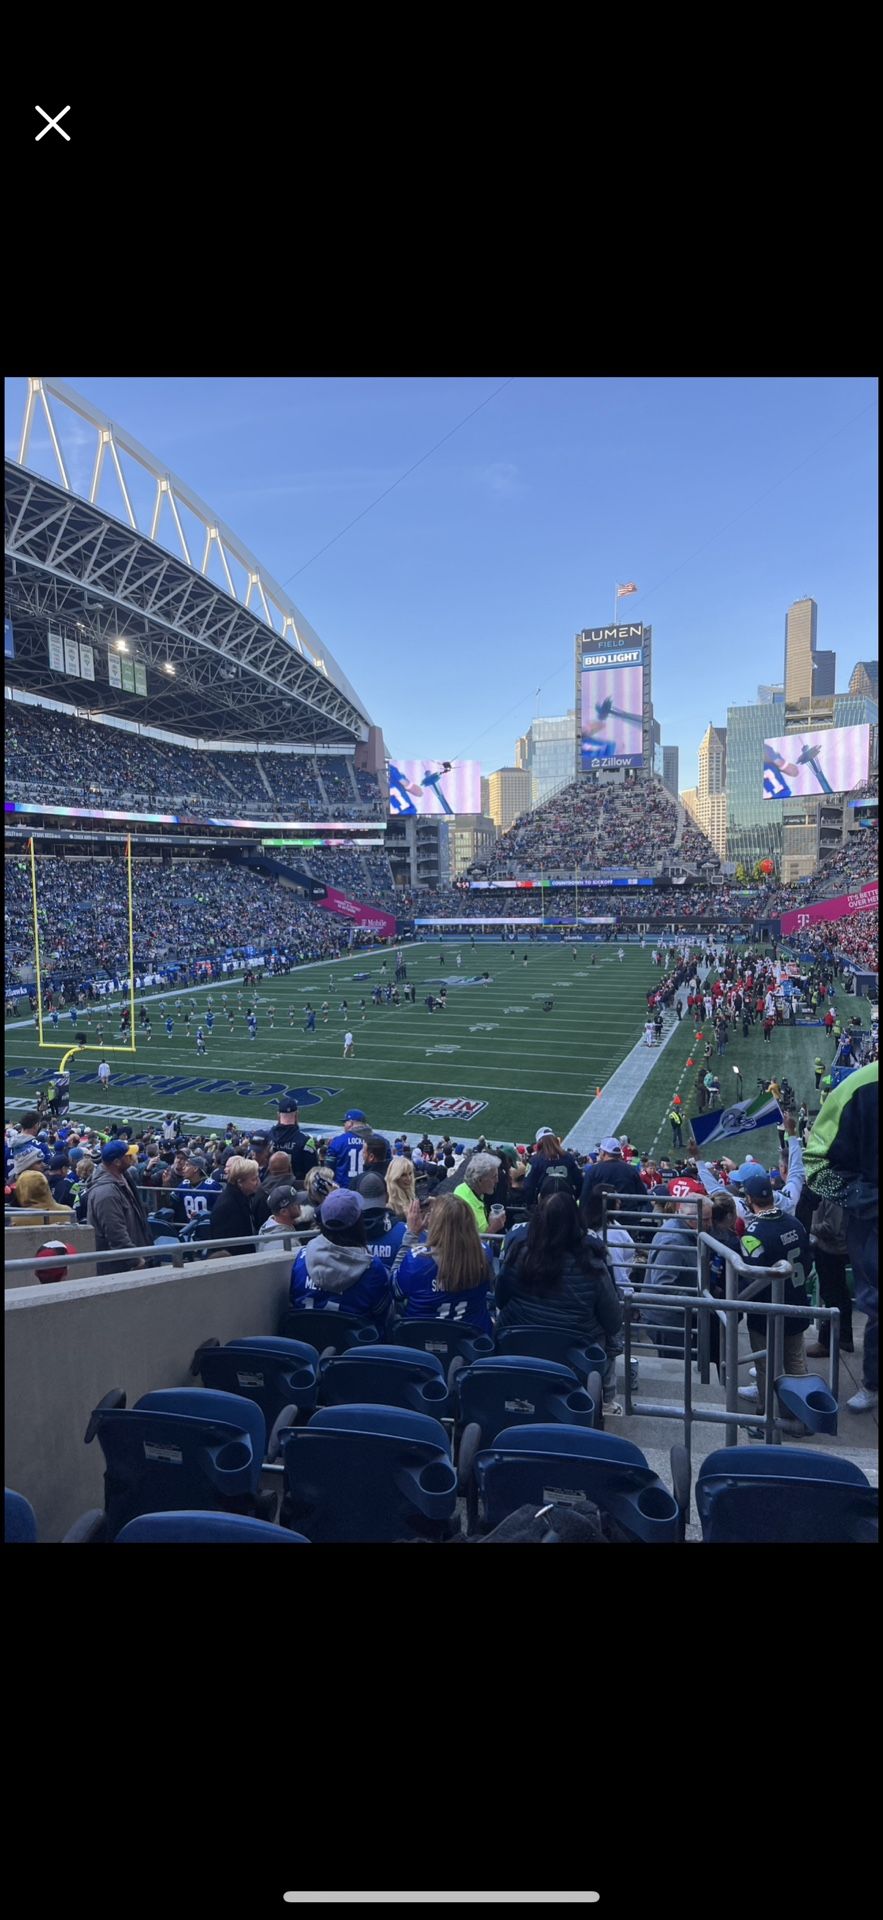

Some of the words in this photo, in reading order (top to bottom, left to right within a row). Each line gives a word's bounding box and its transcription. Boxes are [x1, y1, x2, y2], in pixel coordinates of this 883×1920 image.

[582, 625, 642, 642] LUMEN
[598, 640, 625, 649] FIELD
[585, 655, 607, 665] BUD
[607, 651, 639, 663] LIGHT
[600, 757, 632, 767] Zillow
[848, 897, 867, 908] OVER
[671, 1185, 690, 1199] 97
[184, 1195, 208, 1219] 80
